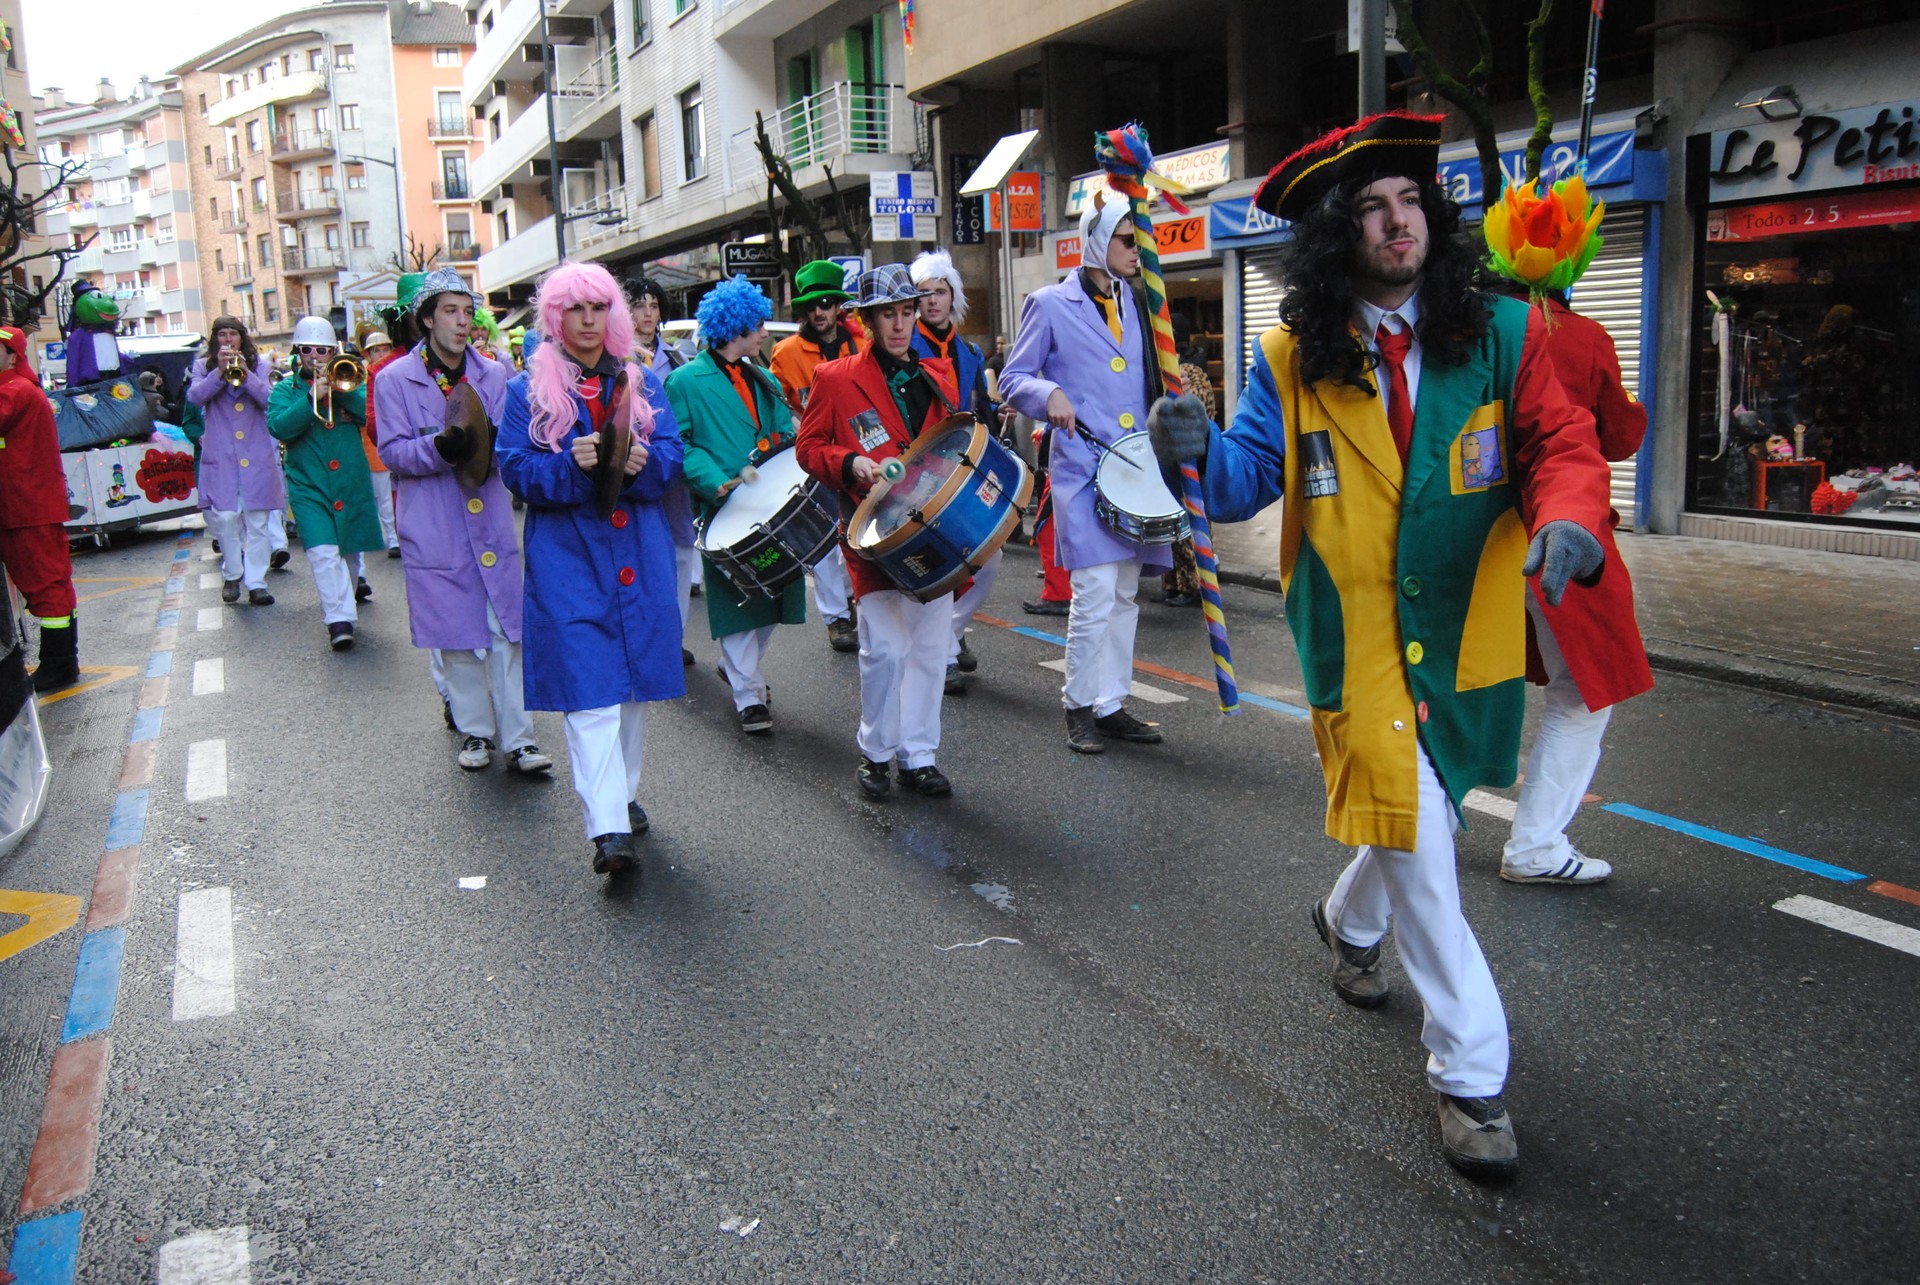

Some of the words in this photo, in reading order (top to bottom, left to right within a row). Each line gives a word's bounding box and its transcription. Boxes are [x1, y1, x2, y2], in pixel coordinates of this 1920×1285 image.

[1710, 130, 1778, 178] Le
[1788, 107, 1920, 181] Peti
[1177, 168, 1214, 186] RMAS
[1864, 163, 1920, 185] Bisut
[878, 205, 933, 214] TOLOSA
[1743, 211, 1784, 229] Todo
[1789, 213, 1797, 225] a
[1804, 207, 1815, 225] 2
[1828, 205, 1839, 223] 5
[1059, 240, 1081, 257] CAL
